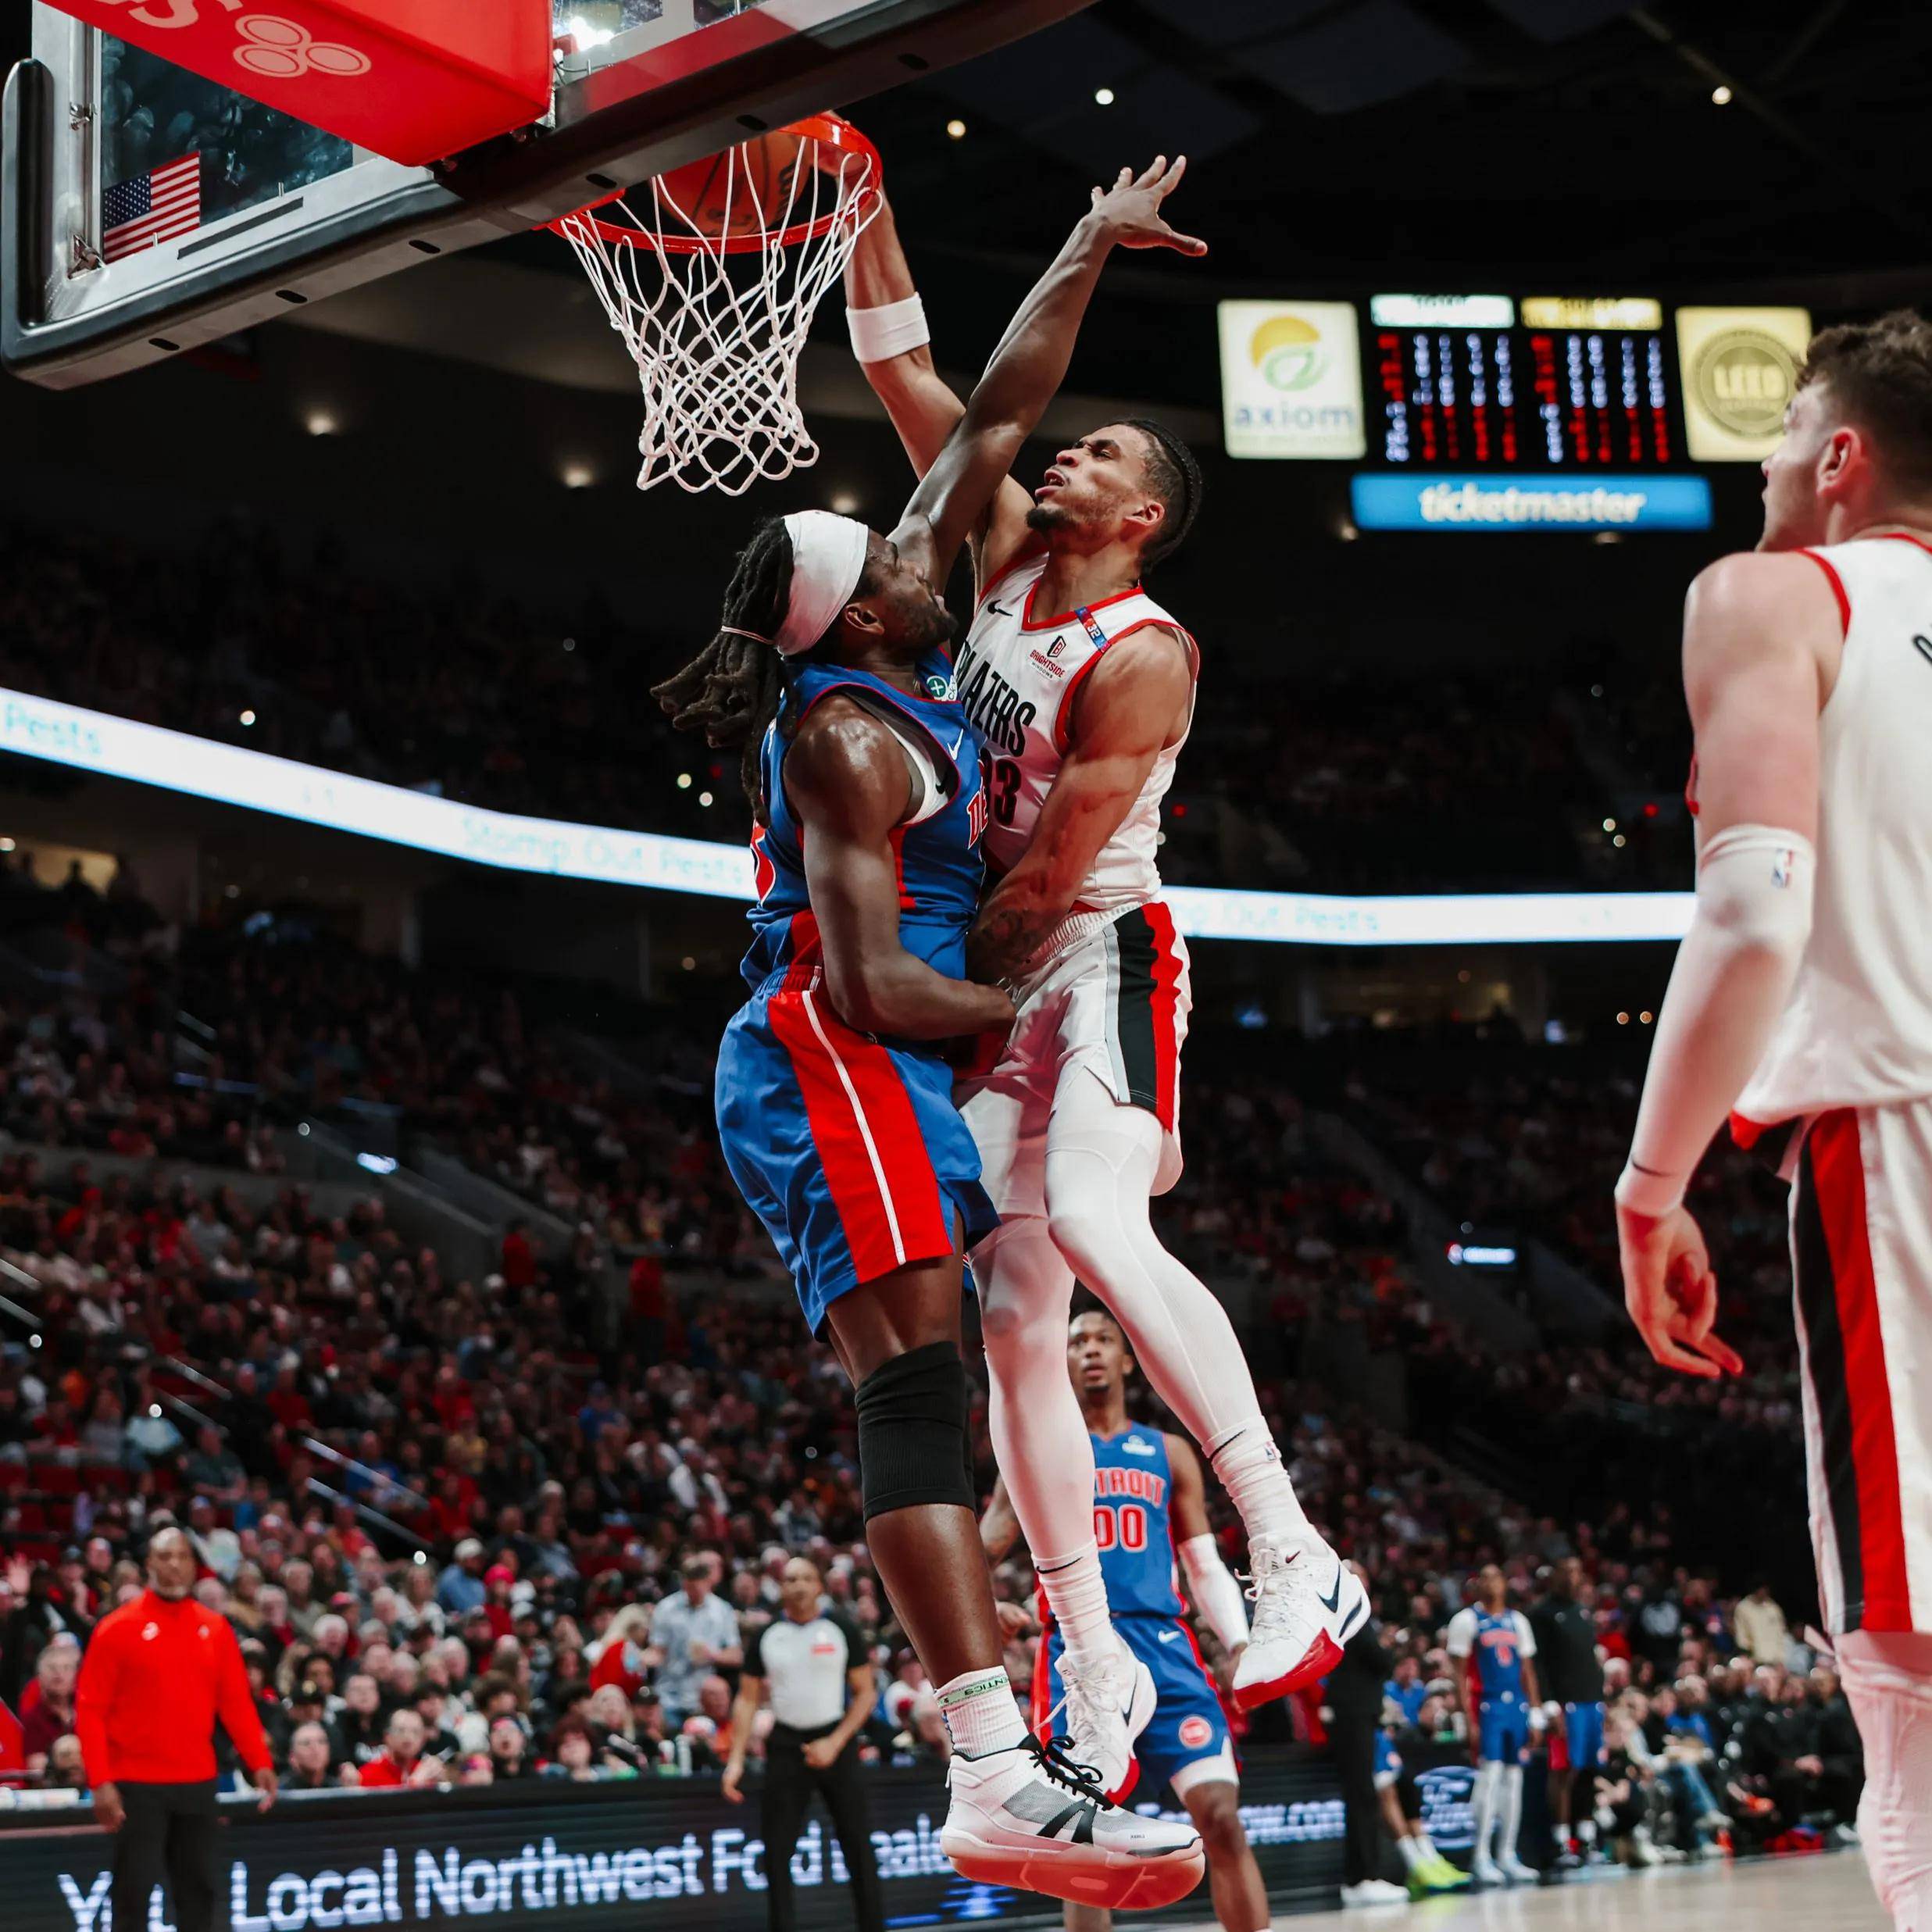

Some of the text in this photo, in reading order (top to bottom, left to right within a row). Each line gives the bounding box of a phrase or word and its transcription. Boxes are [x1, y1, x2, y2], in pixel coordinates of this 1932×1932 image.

[1233, 399, 1356, 430] axiom
[1418, 480, 1647, 523] ticketmaster
[1029, 648, 1066, 678] BRIGHTSIDE
[1095, 1466, 1166, 1509] TROIT
[1094, 1504, 1148, 1553] 00
[230, 1848, 403, 1932] Local
[415, 1833, 704, 1920] Northwest
